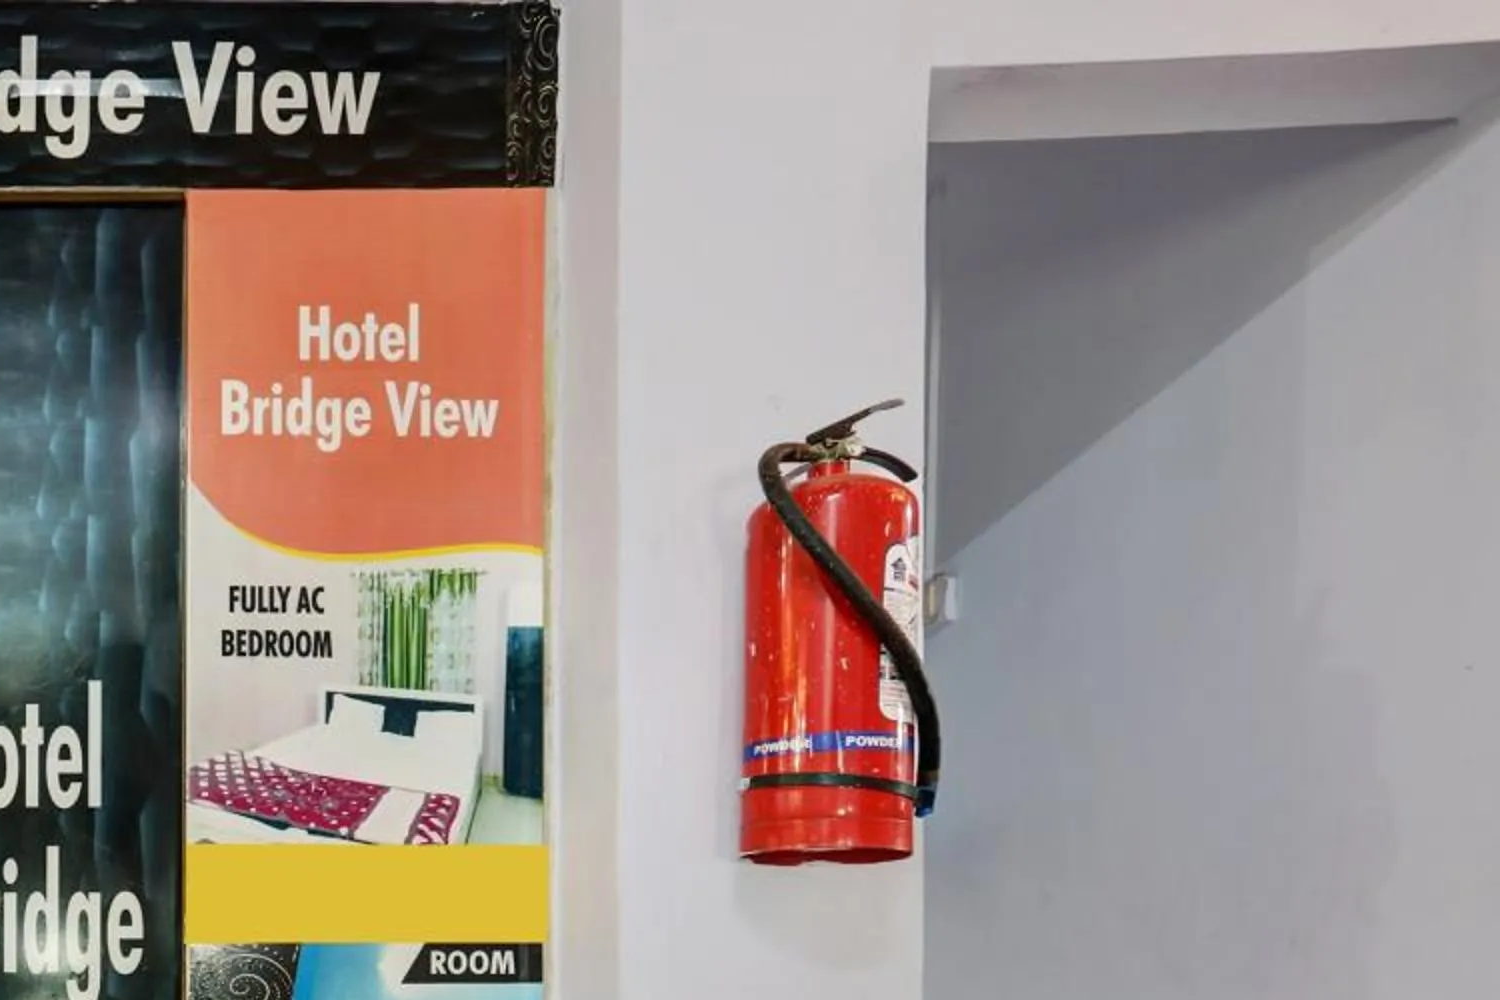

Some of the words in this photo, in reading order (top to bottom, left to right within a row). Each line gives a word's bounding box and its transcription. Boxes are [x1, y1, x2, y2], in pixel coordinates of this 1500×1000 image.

[172, 40, 380, 135] View
[297, 302, 420, 362] Hotel
[220, 376, 372, 452] Bridge
[384, 381, 499, 438] View
[228, 585, 291, 614] FULLY
[296, 585, 325, 614] AC
[221, 629, 333, 659] BEDROOM
[429, 950, 516, 975] ROOM
